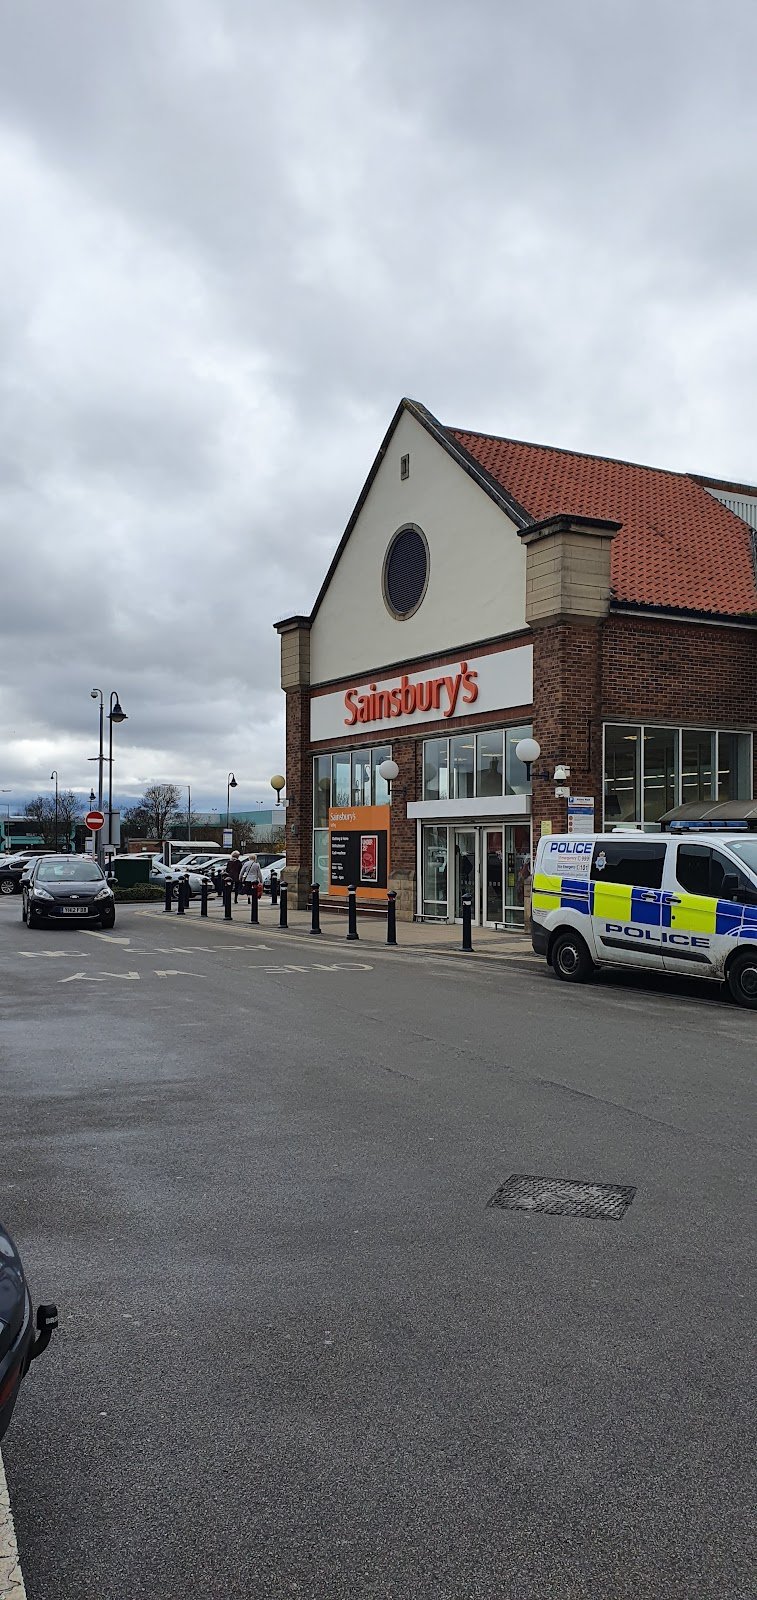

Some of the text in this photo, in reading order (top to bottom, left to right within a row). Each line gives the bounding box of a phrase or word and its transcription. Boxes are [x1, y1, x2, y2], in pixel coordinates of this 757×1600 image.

[344, 662, 479, 725] Sainsbury's
[331, 812, 356, 822] Sainsbury's
[550, 843, 592, 854] POLICE
[605, 923, 710, 949] POLICE
[123, 944, 276, 955] ENTRY
